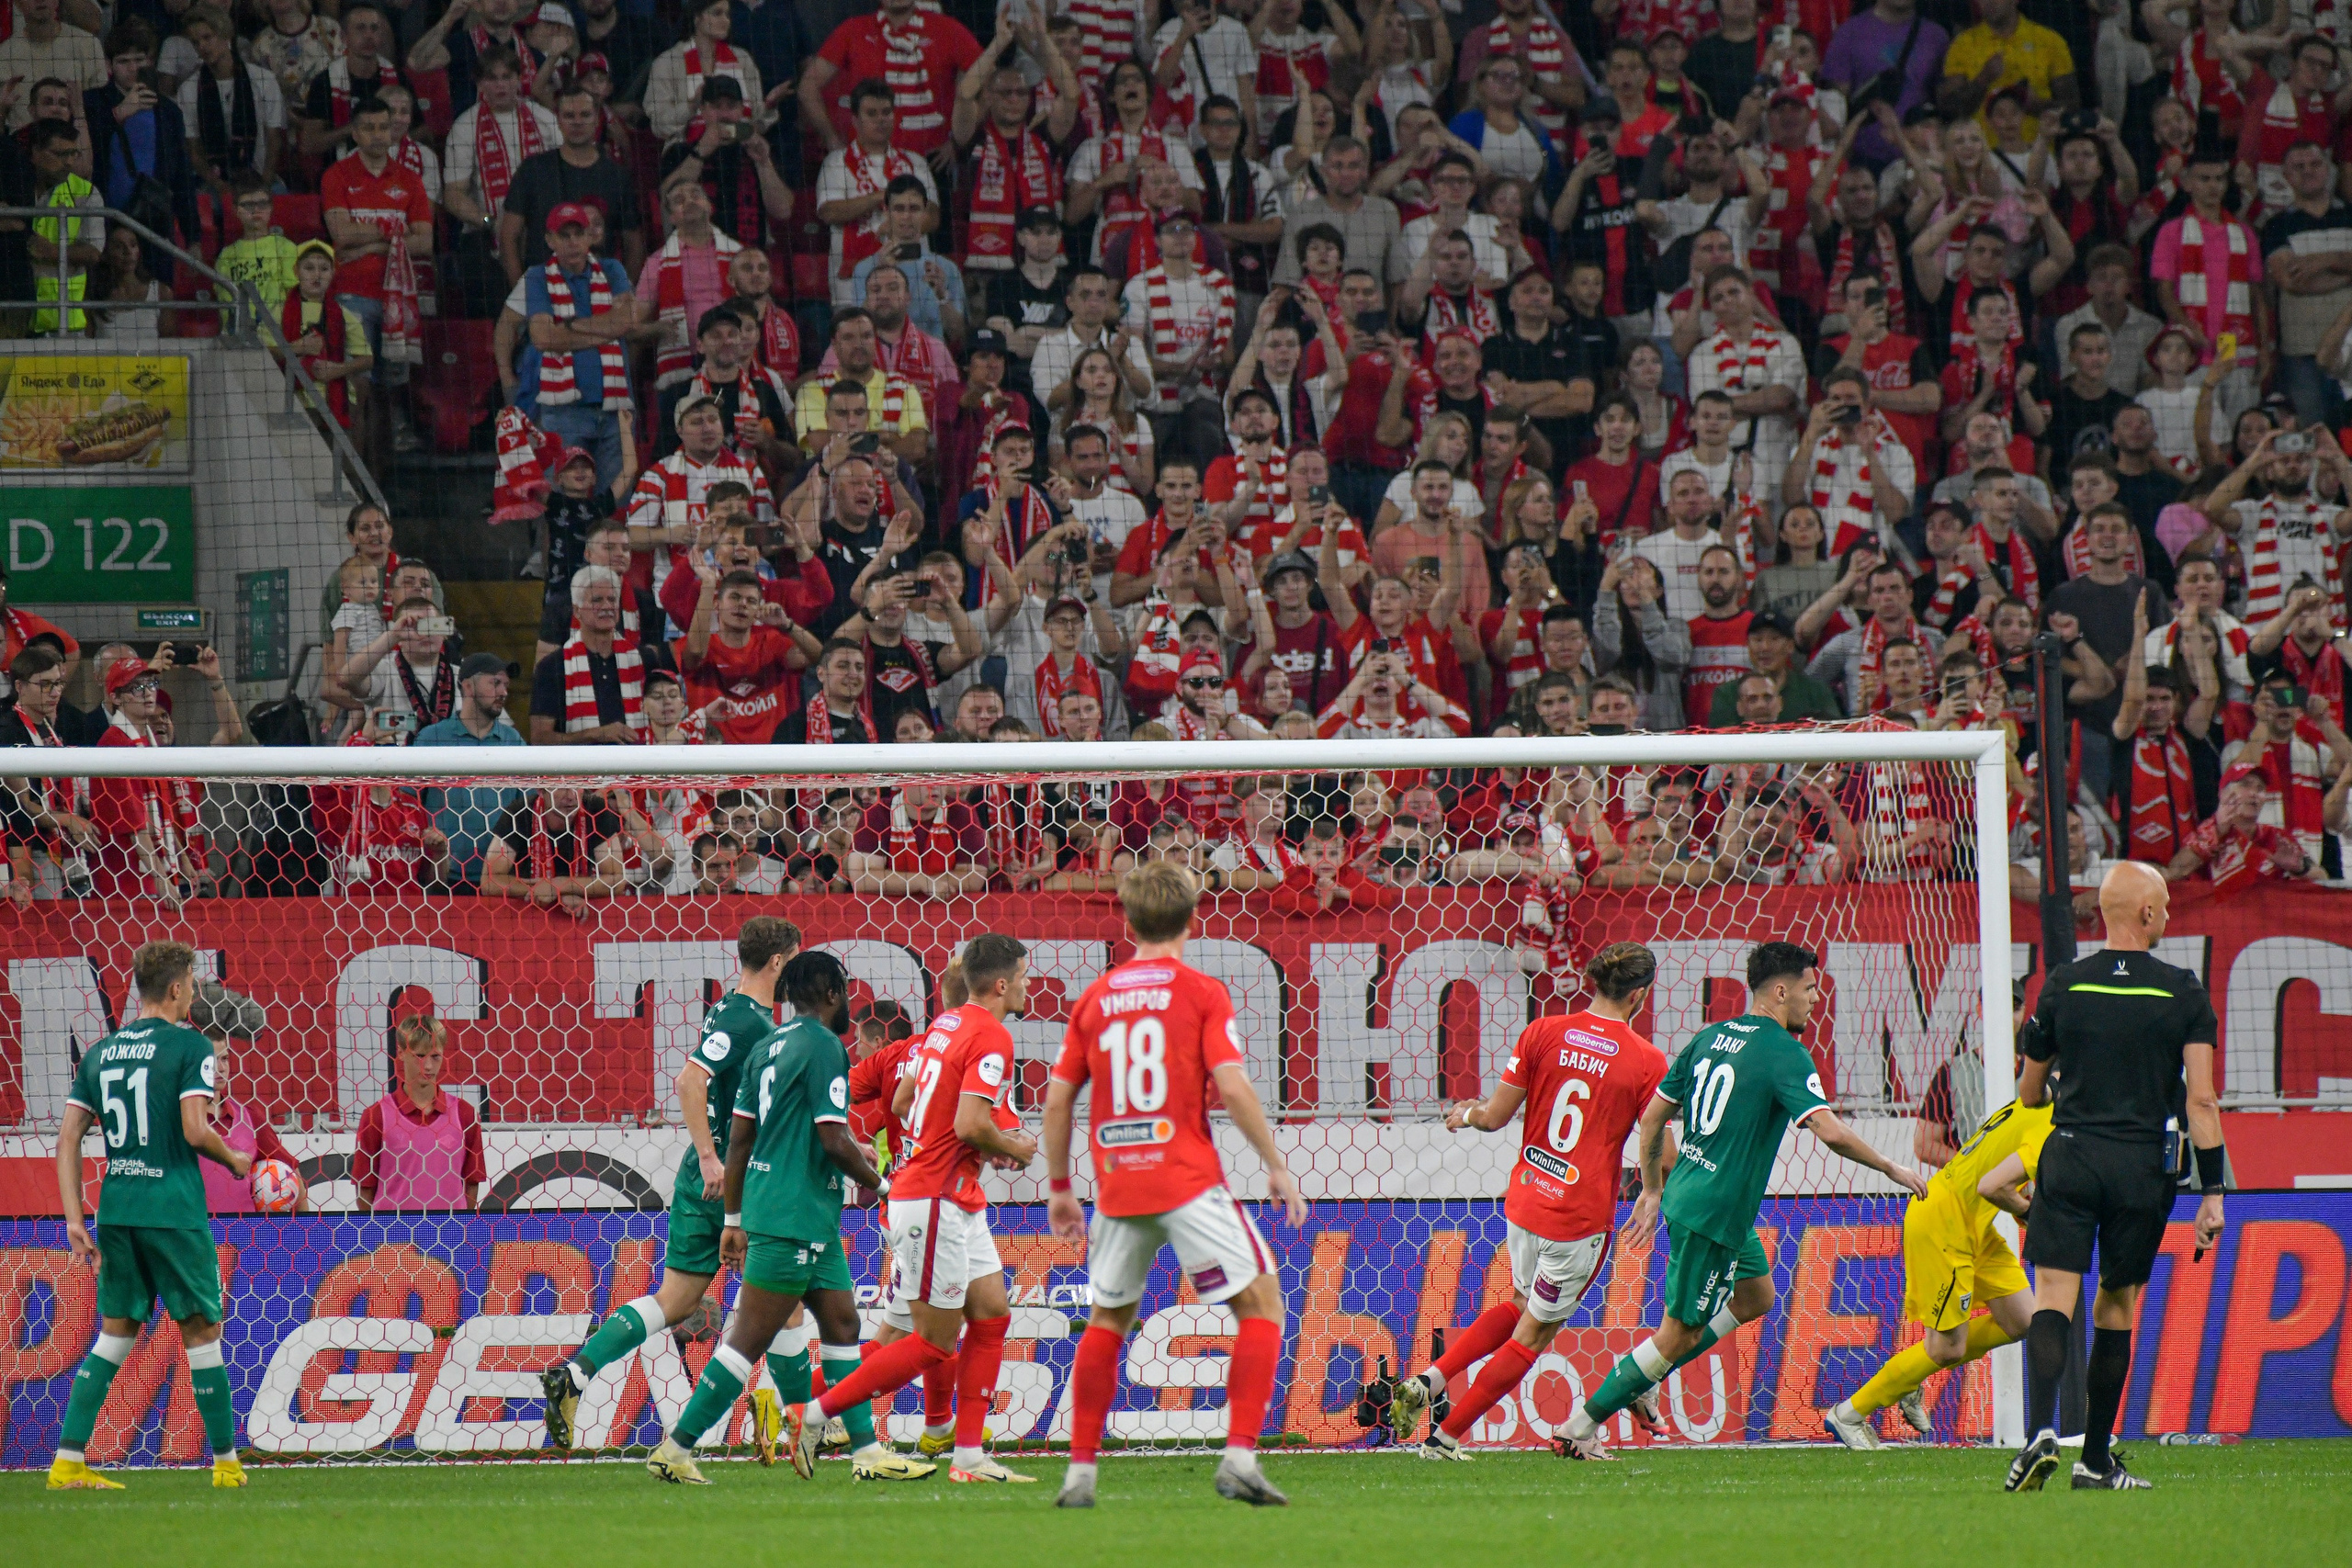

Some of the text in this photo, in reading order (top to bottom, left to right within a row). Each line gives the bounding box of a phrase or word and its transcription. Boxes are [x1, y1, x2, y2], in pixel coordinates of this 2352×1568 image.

[21, 376, 106, 389] Яндекс Еда
[8, 517, 172, 571] D 122
[732, 693, 778, 716] КОЙЛ
[368, 843, 421, 863] УКОЙЛ
[1100, 988, 1172, 1017] УМЯРОВ
[1723, 1021, 1760, 1033] FONBET
[99, 1043, 156, 1065] РОЖКОВ
[1568, 1032, 1616, 1054] wildberries
[1710, 1032, 1747, 1054] ДАКУ
[1099, 1016, 1168, 1116] 18
[1558, 1049, 1610, 1078] БАБИЧ
[99, 1066, 149, 1148] 51
[1690, 1056, 1736, 1136] 10
[1547, 1078, 1591, 1154] 6
[1529, 1148, 1566, 1177] Winline
[1685, 1150, 1717, 1173] СИНТЕЗ
[1532, 1177, 1566, 1199] MELKE
[910, 1240, 920, 1276] MELKE
[1702, 1269, 1720, 1295] КОС
[246, 1303, 1283, 1455] GENSS
